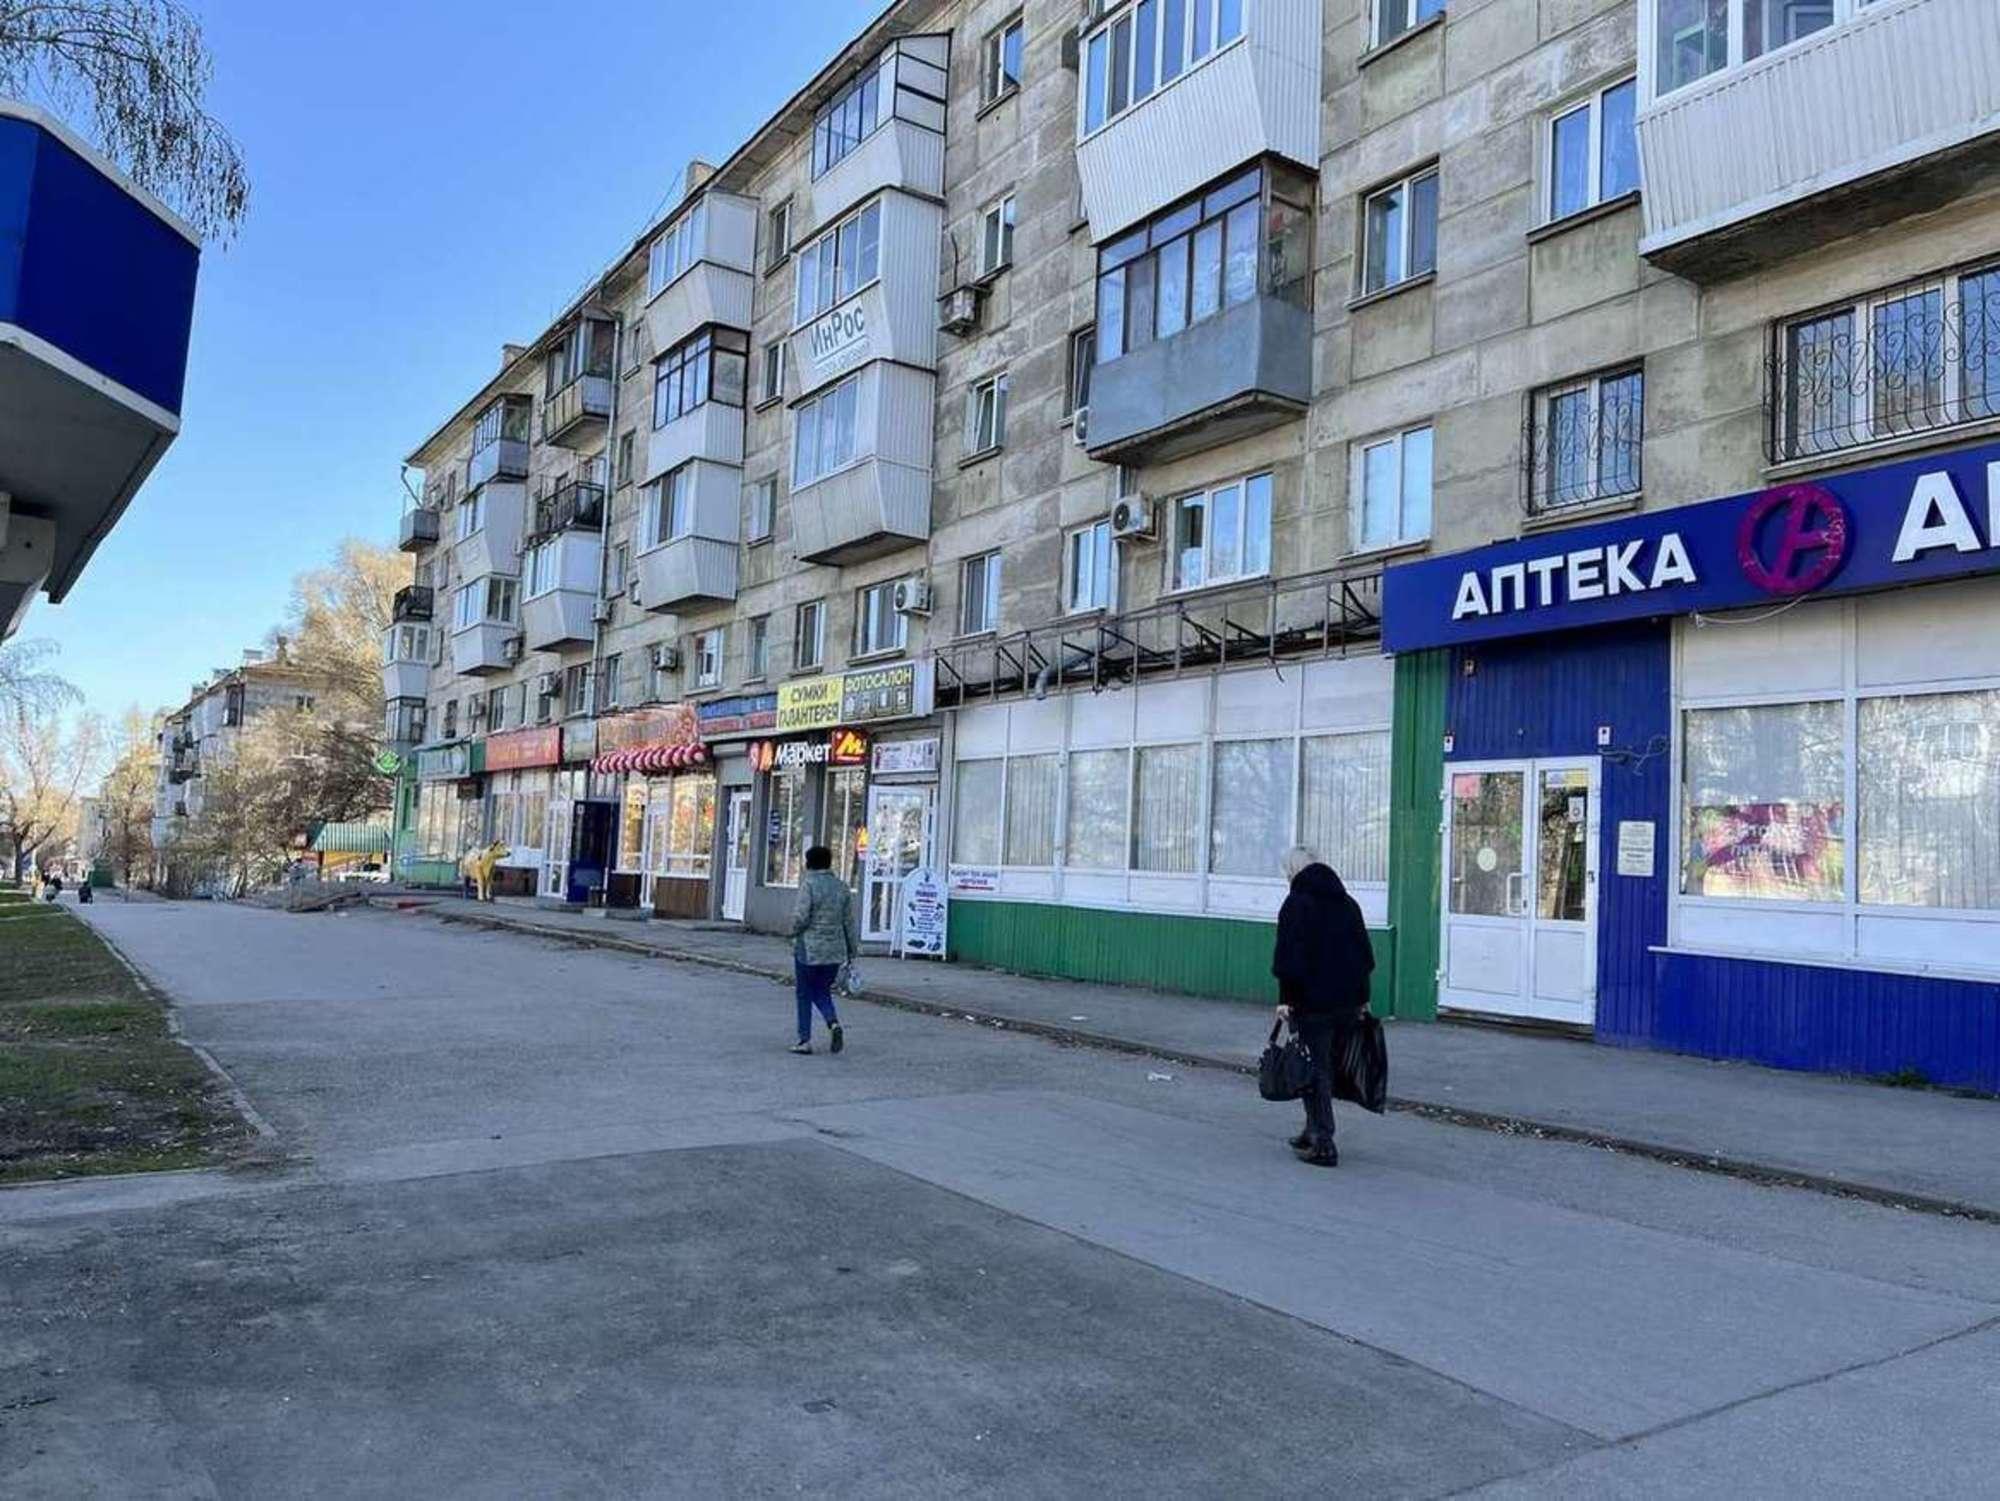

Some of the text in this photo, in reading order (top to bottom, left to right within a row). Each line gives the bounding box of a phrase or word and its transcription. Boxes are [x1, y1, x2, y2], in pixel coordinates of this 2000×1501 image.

[1892, 461, 2000, 562] А
[1452, 533, 1697, 620] АПТЕКА
[845, 667, 912, 692] ФОТОСАЛОН
[791, 683, 828, 704] СУМКИ
[780, 702, 839, 727] ГАЛАНТЕРЕЯ
[775, 741, 831, 768] Маркет
